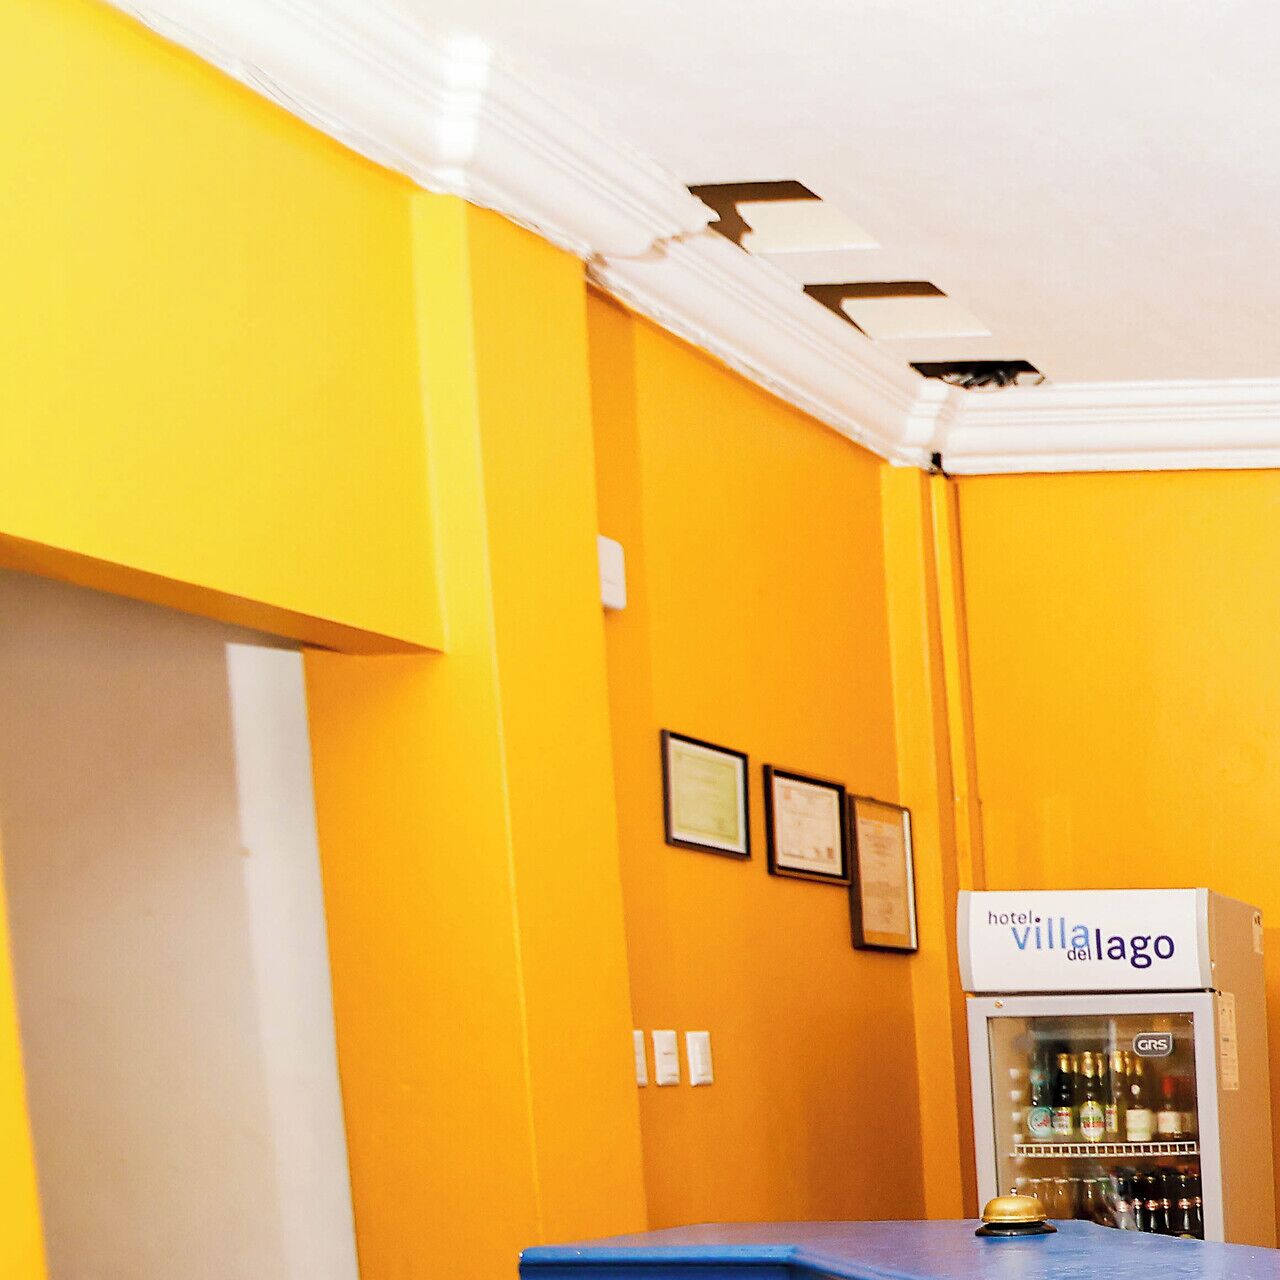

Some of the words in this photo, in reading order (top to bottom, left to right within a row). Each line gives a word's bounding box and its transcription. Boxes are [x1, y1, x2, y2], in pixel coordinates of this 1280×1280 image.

[988, 910, 1032, 925] hotel
[1011, 917, 1090, 950] villa
[1067, 946, 1091, 961] del
[1095, 929, 1175, 968] lago
[1137, 1039, 1168, 1051] GRS
